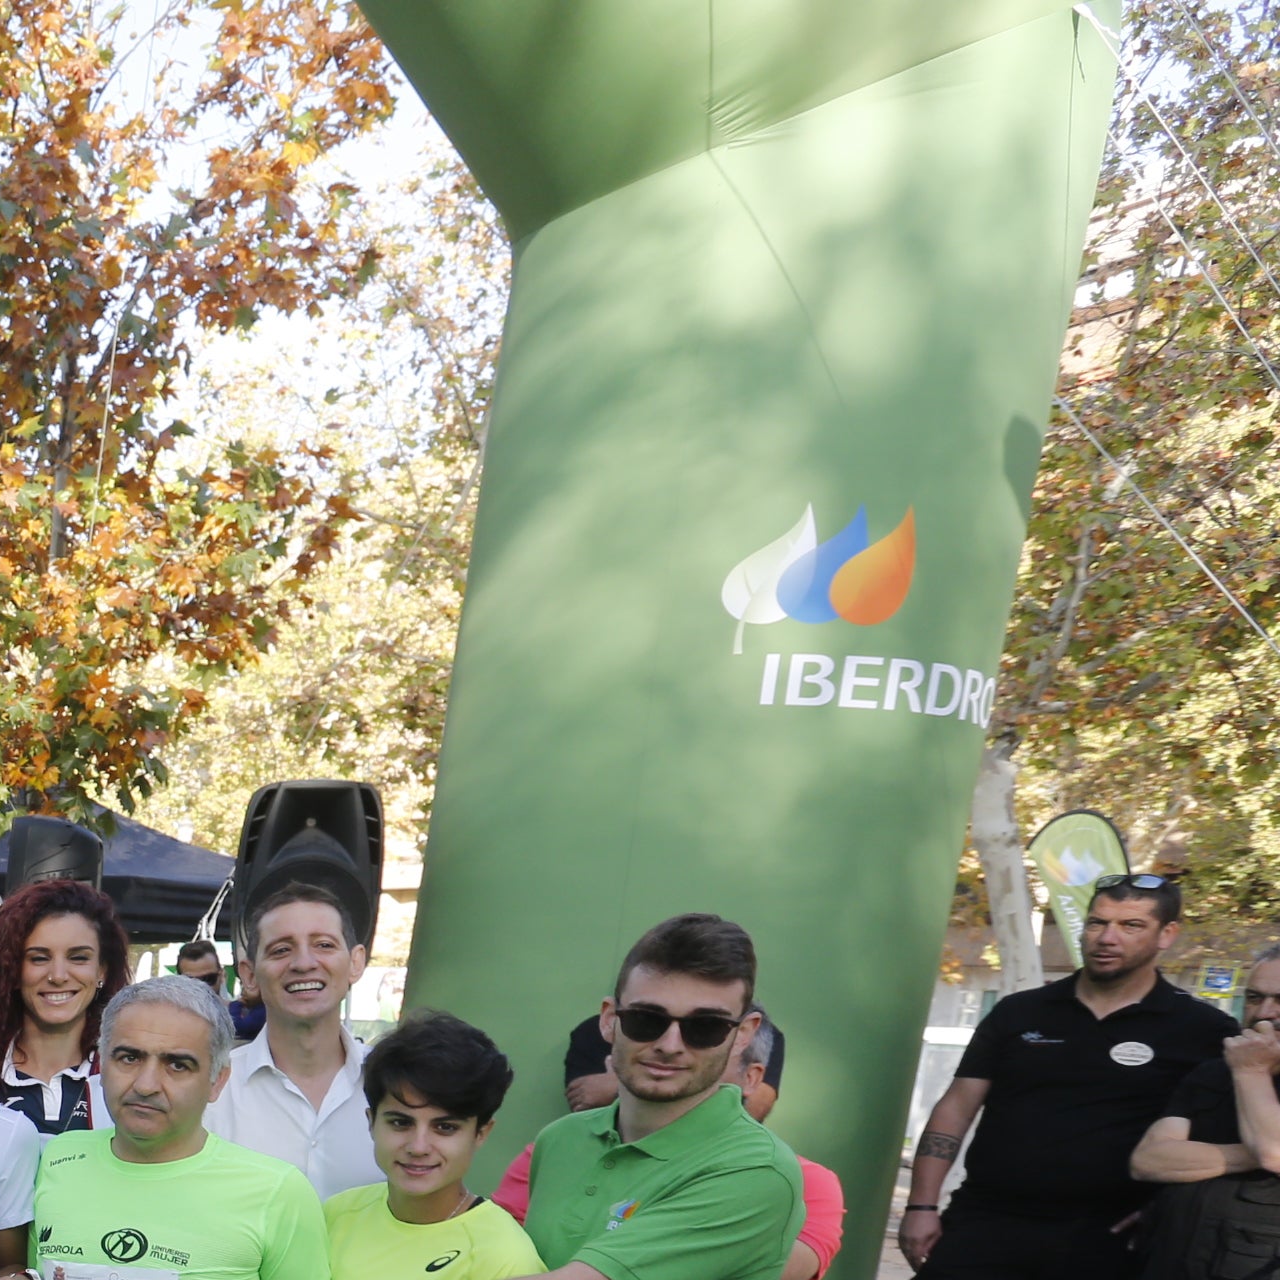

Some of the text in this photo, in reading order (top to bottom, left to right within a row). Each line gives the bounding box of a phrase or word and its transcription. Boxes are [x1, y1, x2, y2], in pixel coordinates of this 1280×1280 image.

[49, 1154, 76, 1167] luanvi
[149, 1251, 189, 1267] MUJER
[151, 1244, 190, 1259] UNIVERSO
